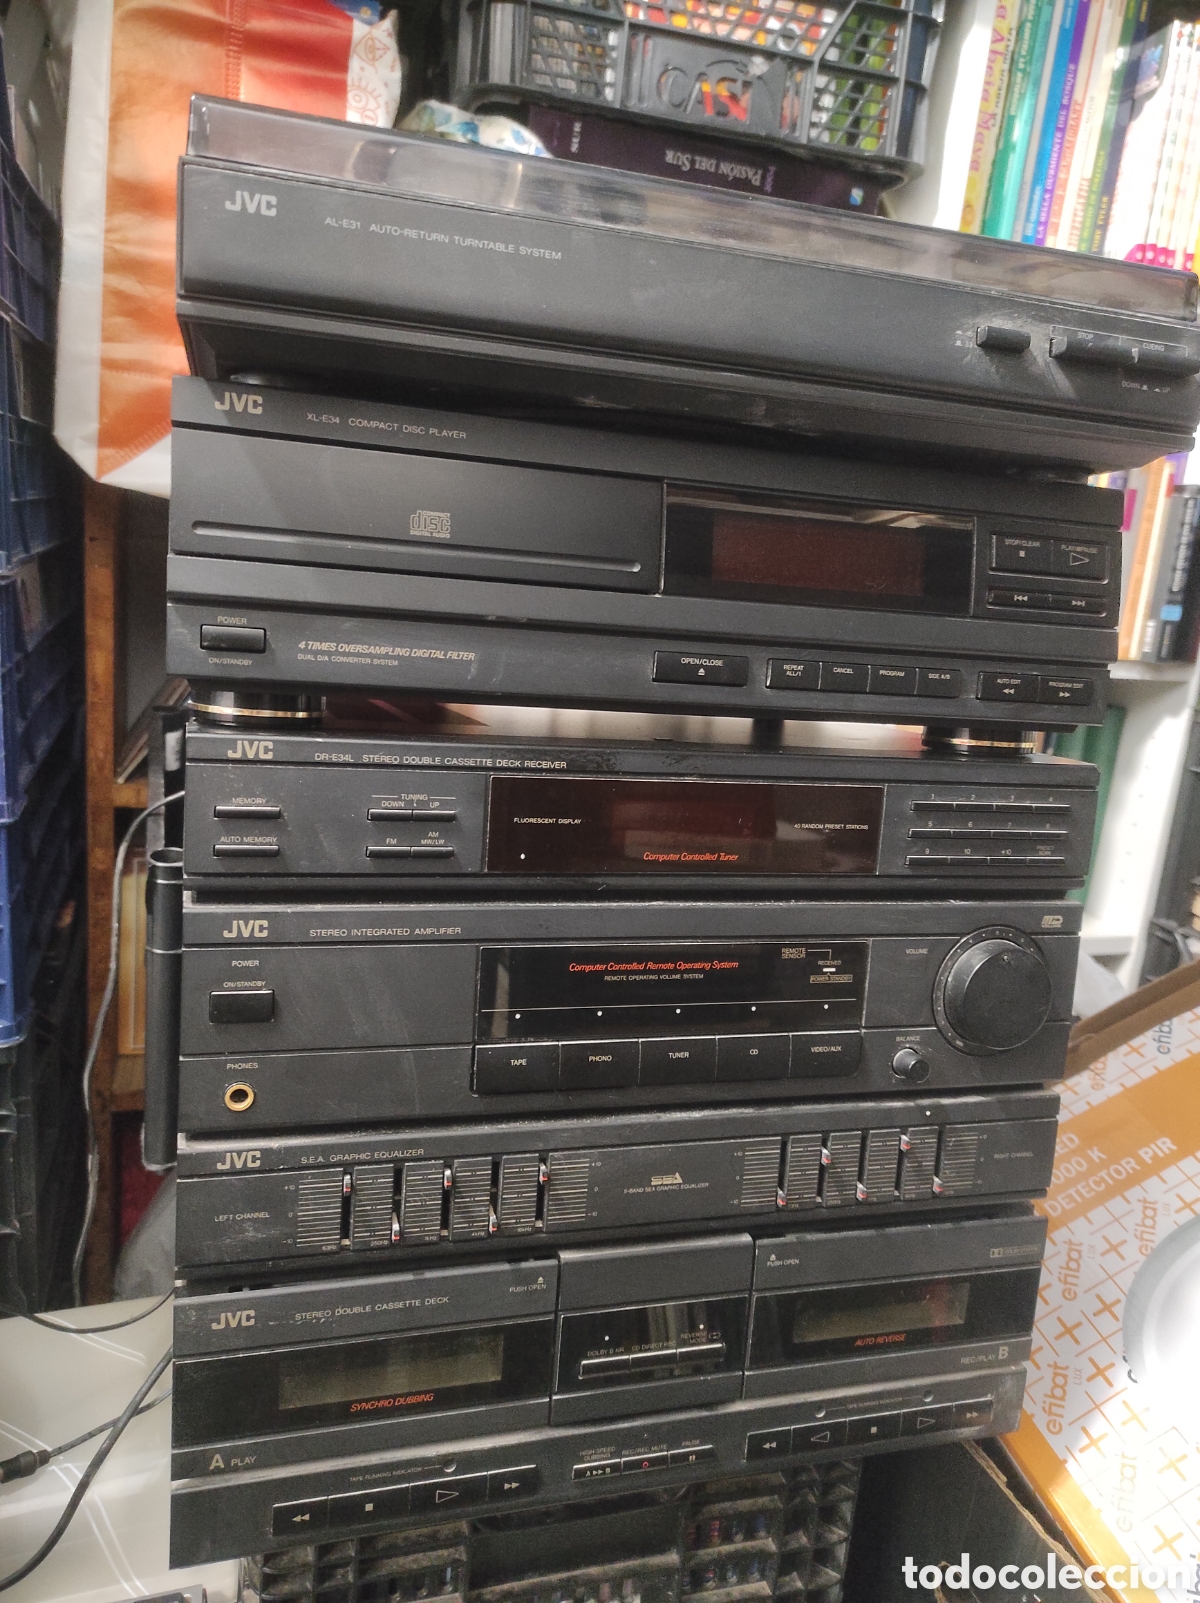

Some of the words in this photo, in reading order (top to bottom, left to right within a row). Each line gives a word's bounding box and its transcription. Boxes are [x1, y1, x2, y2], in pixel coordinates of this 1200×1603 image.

[1062, 63, 1076, 105] BOSQUE
[1057, 109, 1067, 129] DEL
[1045, 131, 1064, 190] DURMIENTE
[225, 190, 277, 217] JVC
[1039, 193, 1051, 223] BELLA
[325, 216, 361, 230] AL-E31
[369, 223, 449, 243] AUTO-RETURN
[454, 235, 516, 255] TURNTABLE
[519, 245, 562, 261] SYSTEM
[1036, 226, 1045, 239] LA
[1077, 332, 1094, 340] STOP
[215, 391, 263, 415] JVC
[307, 412, 340, 424] XL-E34
[349, 417, 399, 432] COMPACT
[402, 424, 426, 435] DISC
[429, 427, 467, 439] PLAYER
[217, 616, 247, 625] POWER
[298, 641, 306, 649] 4
[307, 641, 336, 651] TIMES
[338, 643, 410, 657] OVERSAMPLING
[411, 648, 446, 660] DIGITAL
[446, 651, 475, 661] FILTER
[208, 657, 253, 666] ON/STANDBY
[297, 653, 315, 661] DUAL
[331, 656, 371, 665] CONVERTER
[373, 658, 398, 666] SYSTEM
[680, 657, 724, 667] OPEN/CLOSE
[227, 740, 274, 760] JVC
[314, 752, 354, 762] DR-E34L
[362, 754, 400, 764] STEREO
[403, 756, 442, 766] DOUBLE
[444, 757, 493, 767] CASSETTE
[496, 759, 522, 768] DECK
[524, 760, 567, 769] RECEIVER
[232, 797, 267, 805] MEMORY
[400, 793, 428, 801] TUNING
[381, 800, 405, 808] DOWN
[429, 801, 440, 809] UP
[513, 817, 557, 825] FLUORESCENT
[558, 818, 582, 826] DISPLAY
[220, 835, 241, 844] AUTO
[243, 836, 278, 845] MEMORY
[385, 837, 397, 845] FM
[420, 838, 445, 846] MW/LW
[643, 852, 680, 863] Computer
[681, 852, 718, 862] Controlled
[719, 852, 739, 862] Tuner
[223, 920, 269, 938] JVC
[309, 928, 347, 937] STEREO
[351, 928, 410, 936] INTEGRATED
[414, 927, 462, 935] AMPLIFIER
[231, 960, 260, 968] POWER
[569, 962, 606, 973] Computer
[607, 961, 645, 971] Controlled
[647, 961, 674, 970] Remote
[676, 960, 711, 972] Operating
[712, 960, 739, 970] System
[223, 980, 266, 988] ON/STANDBY
[668, 1051, 690, 1059] TUNER
[811, 1045, 842, 1054] VIDEO/AUX
[510, 1058, 527, 1066] TAPE
[588, 1054, 612, 1063] PHONO
[226, 1062, 259, 1070] PHONES
[1054, 1132, 1079, 1157] ED
[216, 1150, 261, 1170] JVC
[330, 1152, 371, 1162] GRAPHIC
[374, 1149, 425, 1159] EQUALIZER
[1050, 1156, 1087, 1187] 000
[1087, 1146, 1107, 1163] K
[651, 1172, 683, 1186] SEA
[1043, 1157, 1141, 1217] DETECTOR
[1138, 1136, 1177, 1164] PIR
[656, 1184, 680, 1192] GRAPHIC
[680, 1182, 709, 1190] EQUALIZER
[214, 1213, 233, 1222] LEFT
[235, 1211, 270, 1221] CHANNEL
[1134, 1197, 1158, 1257] efibat
[767, 1259, 783, 1267] PUSH
[784, 1258, 800, 1266] OPEN
[1057, 1238, 1084, 1301] efibat
[509, 1285, 527, 1294] PUSH
[528, 1283, 547, 1292] OPEN
[295, 1308, 332, 1321] STEREO
[335, 1305, 372, 1316] DOUBLE
[375, 1299, 422, 1312] CASSETTE
[424, 1296, 449, 1306] DECK
[211, 1310, 256, 1330] JVC
[854, 1337, 875, 1347] AUTO
[876, 1334, 907, 1344] REVERSE
[588, 1349, 608, 1357] DOLBY
[960, 1354, 996, 1365] REC/PLAY
[998, 1346, 1009, 1360] B
[1072, 1367, 1084, 1386] LUX
[350, 1399, 394, 1412] SYNCHRO
[395, 1393, 435, 1407] DUBBING
[1042, 1361, 1069, 1436] efibat
[209, 1454, 225, 1470] A
[231, 1455, 258, 1467] PLAY
[392, 1466, 423, 1477] INDICATOR
[1111, 1451, 1138, 1533] efibat
